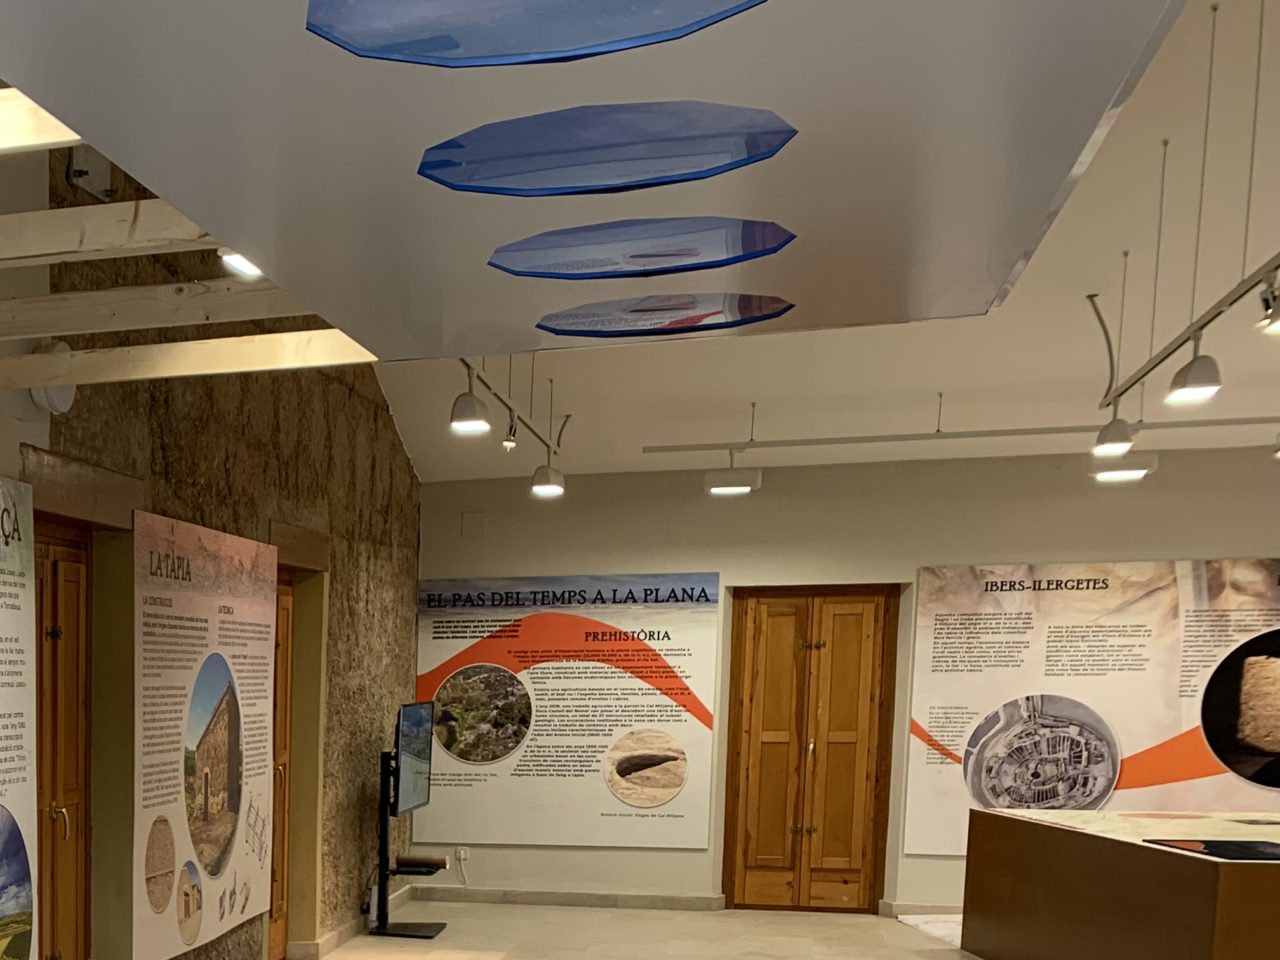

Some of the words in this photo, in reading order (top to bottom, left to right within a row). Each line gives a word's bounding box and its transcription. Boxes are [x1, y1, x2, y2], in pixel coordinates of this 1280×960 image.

[150, 550, 163, 577] LA
[164, 548, 192, 582] TÀPIA
[984, 578, 1110, 592] IBERS-ILERGETES
[426, 593, 447, 608] EL
[452, 592, 486, 608] PAS
[487, 591, 526, 607] DEL
[530, 590, 587, 605] TEMPS
[592, 589, 606, 604] A
[612, 588, 638, 604] LA
[643, 587, 711, 603] PLANA
[585, 628, 671, 642] PREHISTÒRIA
